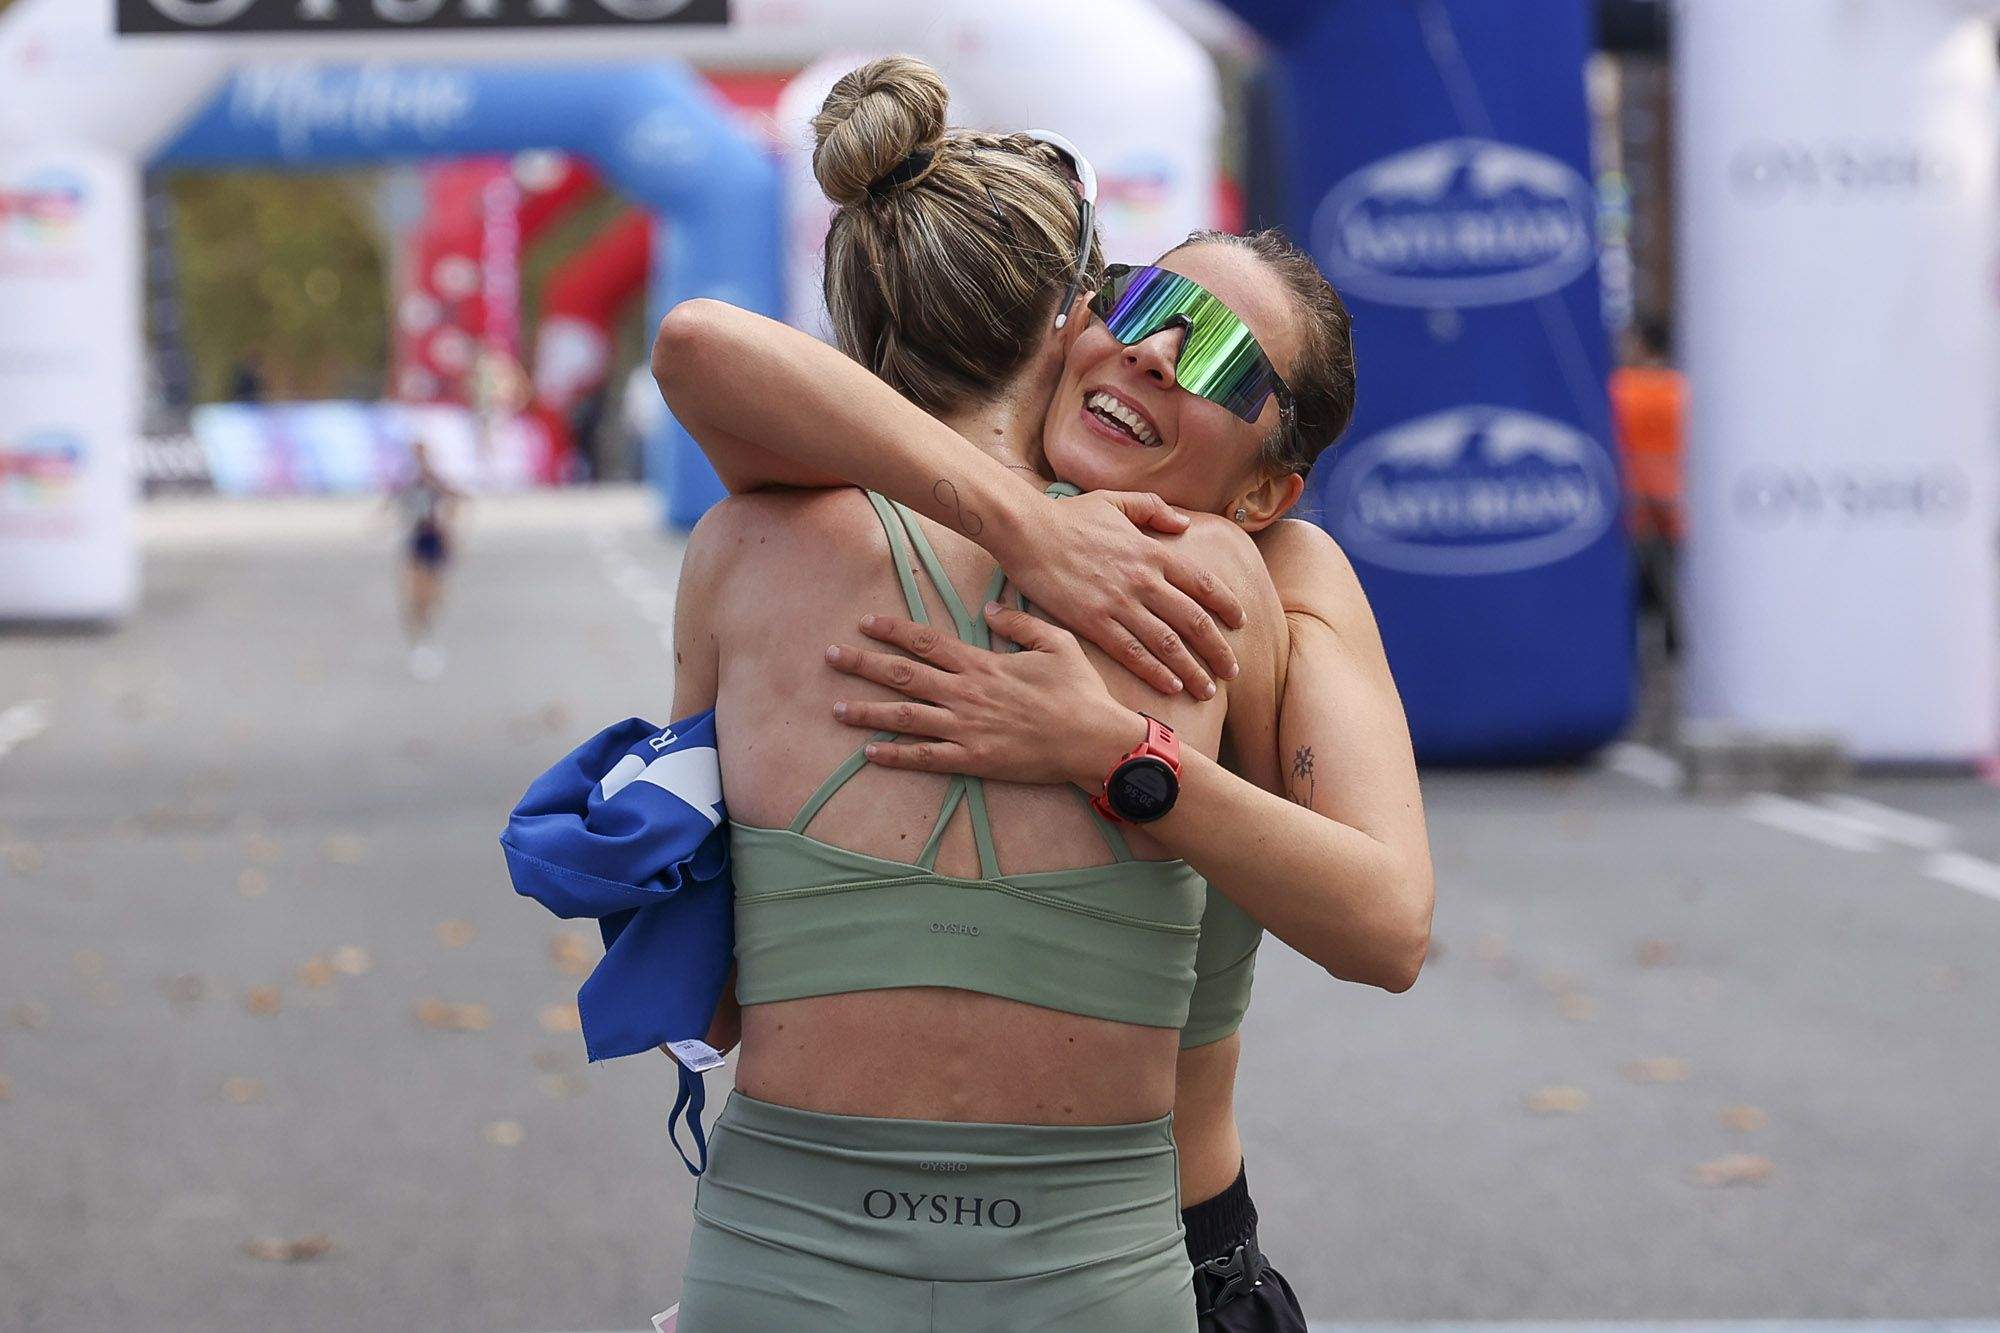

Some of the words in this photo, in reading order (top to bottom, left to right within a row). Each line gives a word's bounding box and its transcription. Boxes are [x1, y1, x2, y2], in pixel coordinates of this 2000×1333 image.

[929, 921, 982, 937] OYSHO
[919, 1159, 969, 1173] OYSHO
[863, 1189, 1022, 1229] OYSHO
